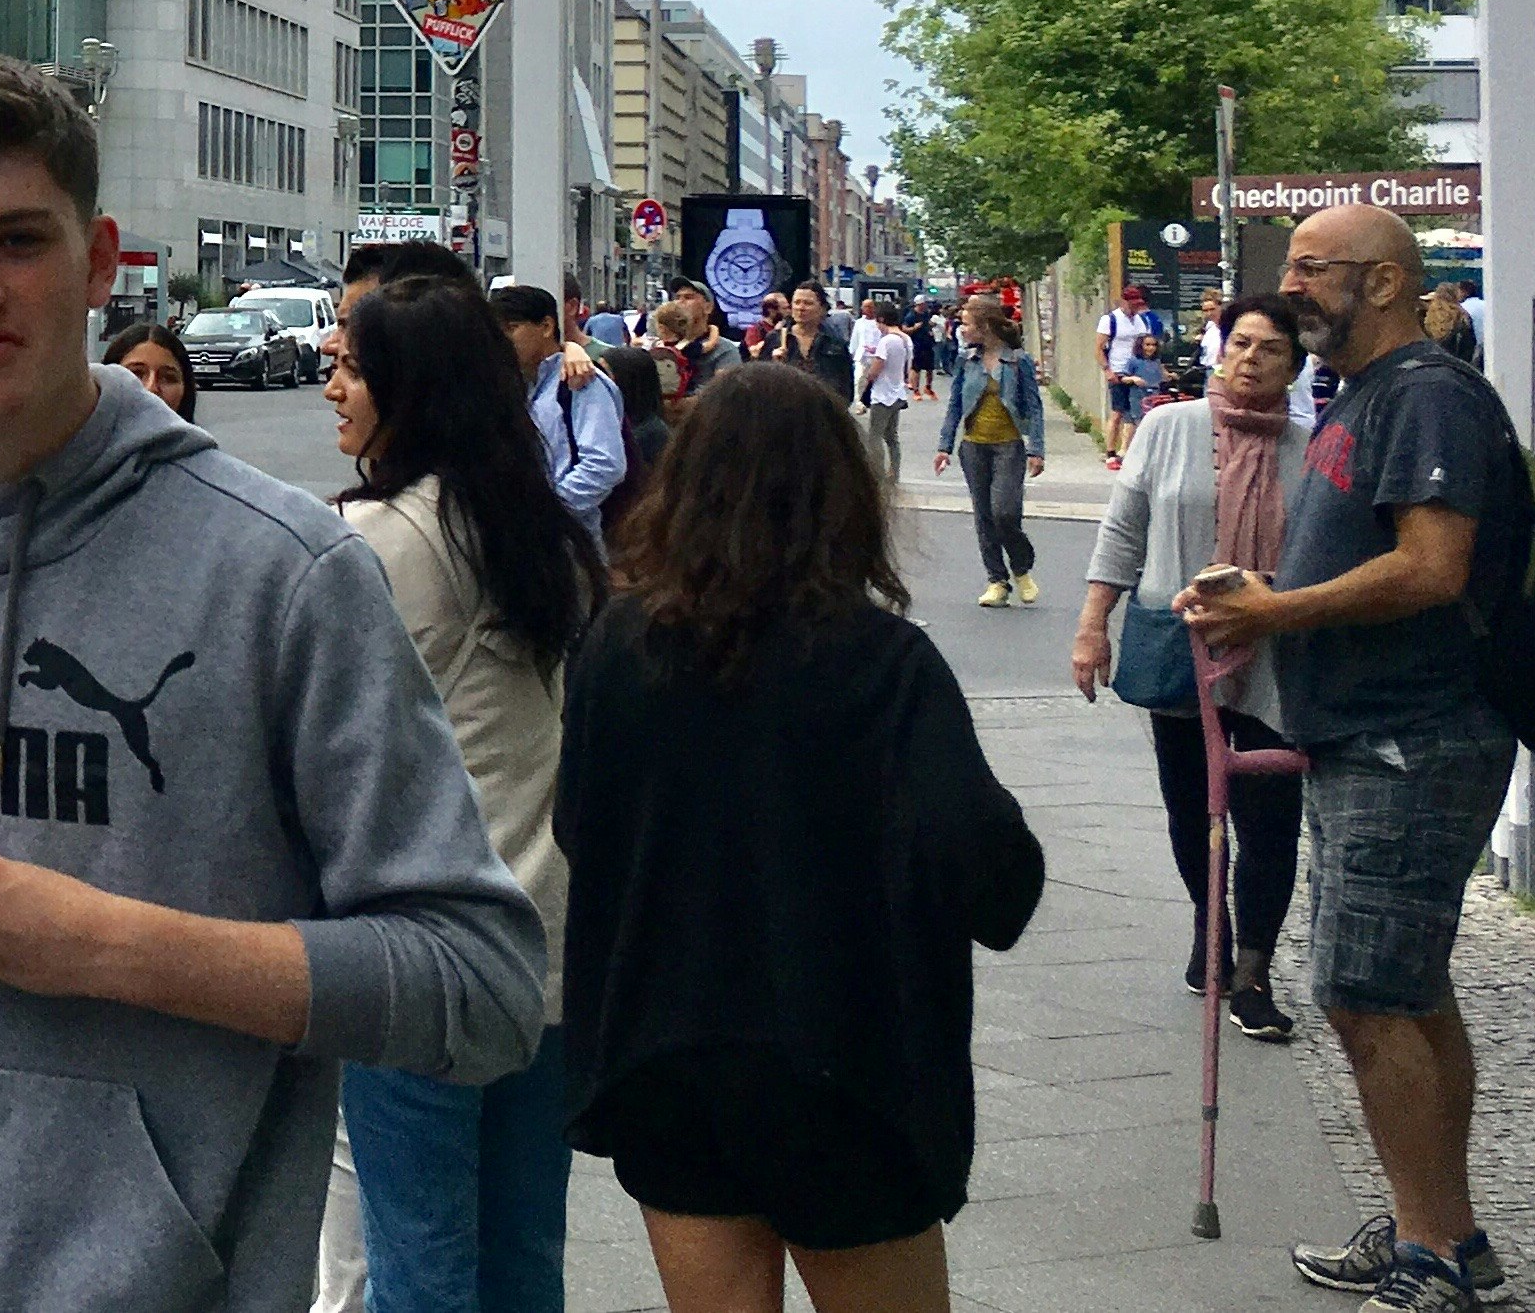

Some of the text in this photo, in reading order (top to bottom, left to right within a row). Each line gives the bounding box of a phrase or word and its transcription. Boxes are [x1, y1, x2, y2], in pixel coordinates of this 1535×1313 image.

[1211, 177, 1470, 213] Checkpoint Charlie
[398, 230, 437, 241] PIZZA
